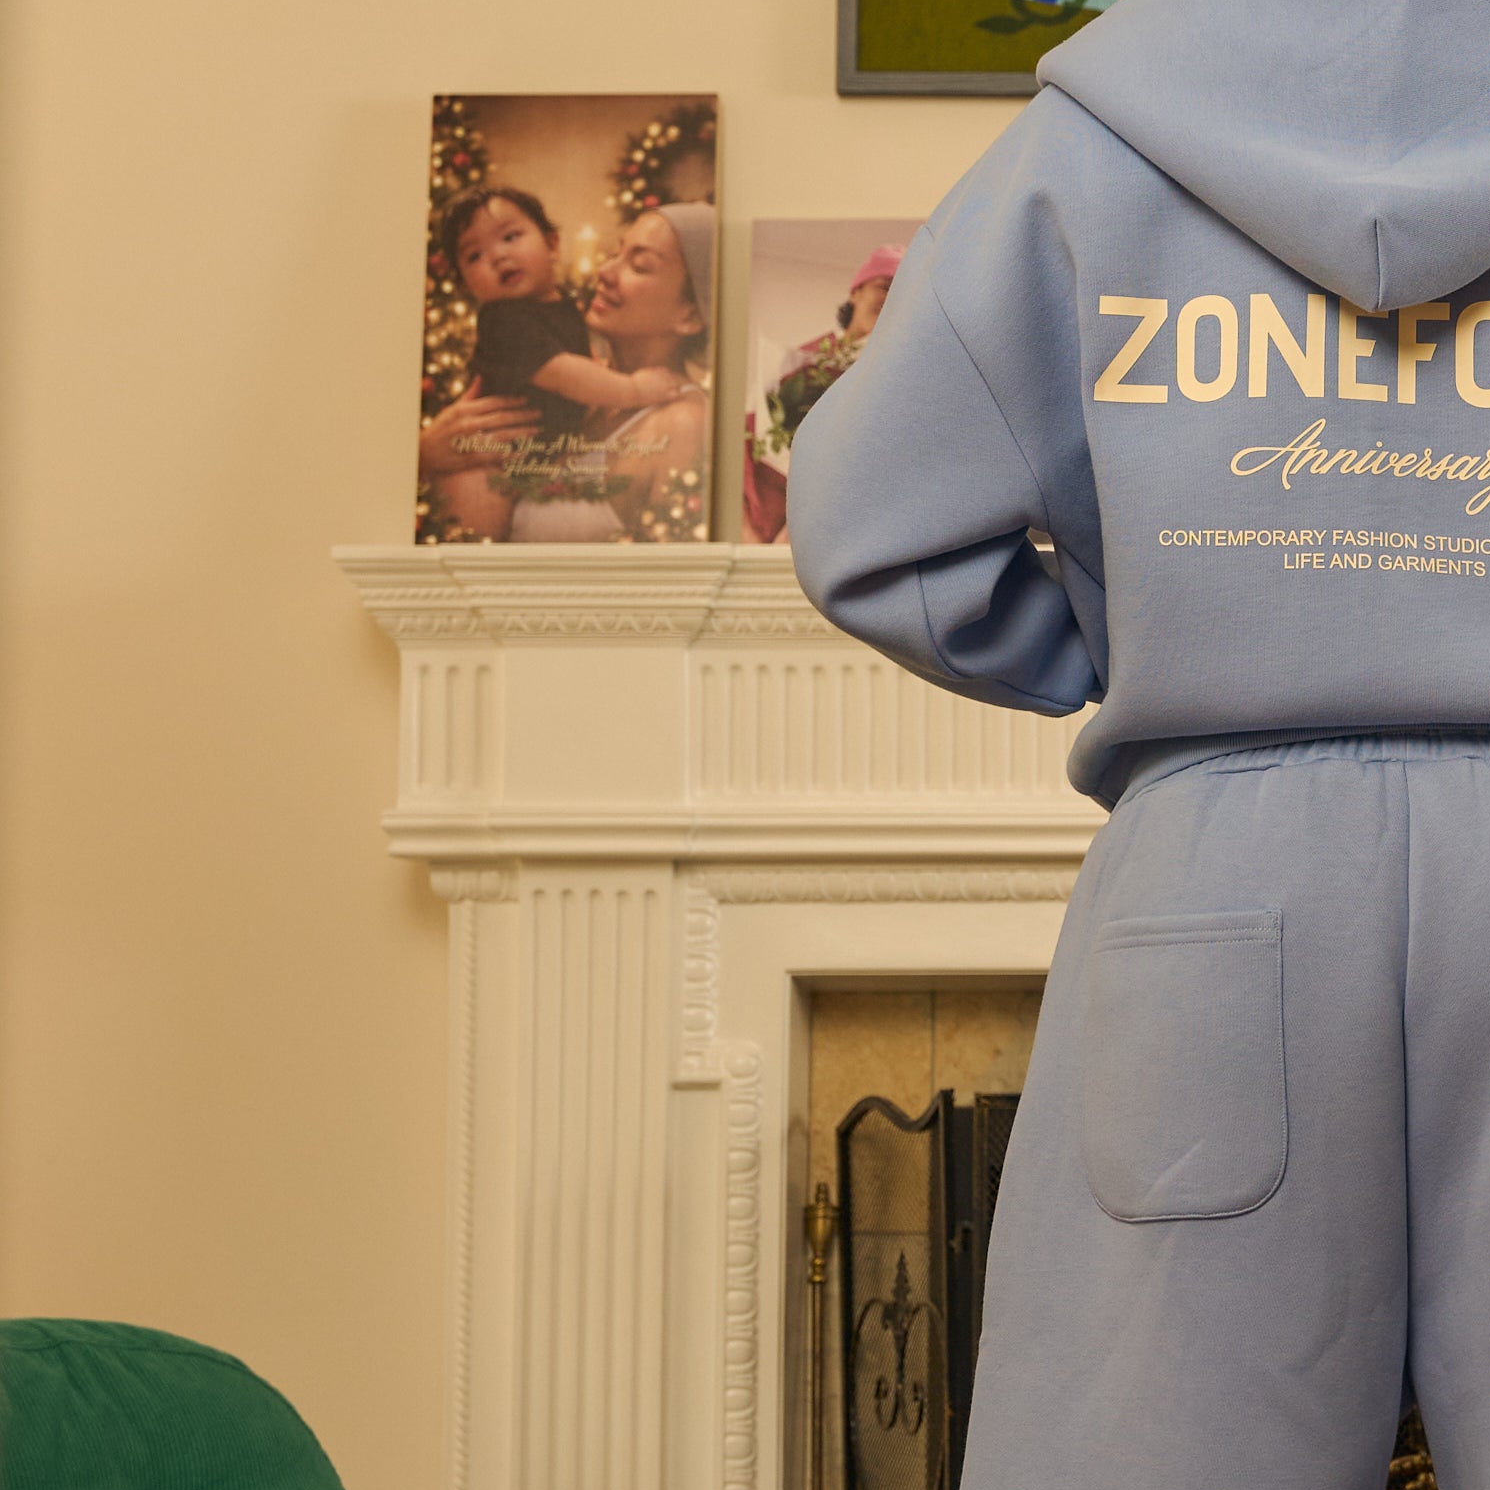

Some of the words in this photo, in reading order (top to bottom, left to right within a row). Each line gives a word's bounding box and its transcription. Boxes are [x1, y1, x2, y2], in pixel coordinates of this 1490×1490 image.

[1158, 529, 1327, 547] CONTEMPORARY
[1332, 529, 1418, 549] FASHION
[1283, 553, 1325, 569] LIFE
[1329, 553, 1372, 569] AND
[1378, 554, 1486, 577] GARMENTS
